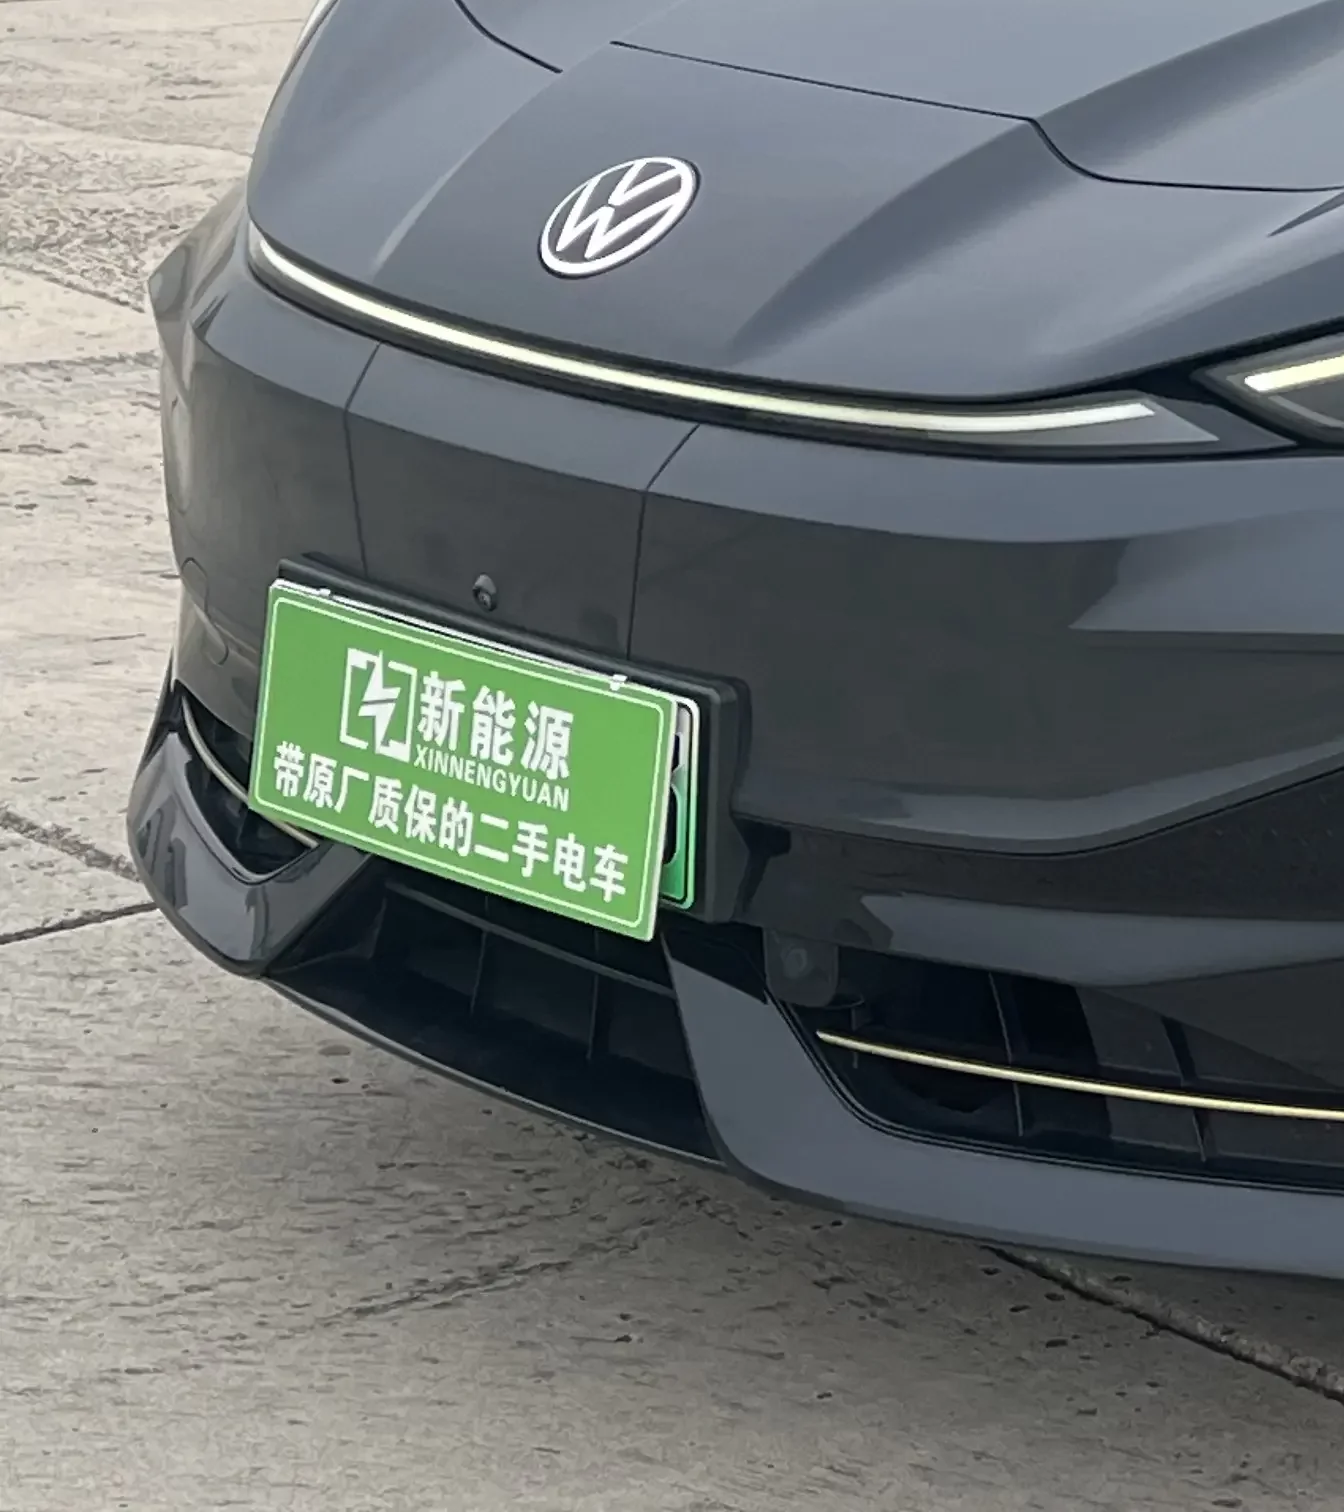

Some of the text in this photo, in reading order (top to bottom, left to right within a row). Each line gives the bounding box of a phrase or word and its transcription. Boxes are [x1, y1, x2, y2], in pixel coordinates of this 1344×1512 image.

[413, 743, 570, 812] XINNENGYUAN
[416, 670, 574, 781] 新能源
[273, 740, 629, 903] 带原厂质保的二手电车
